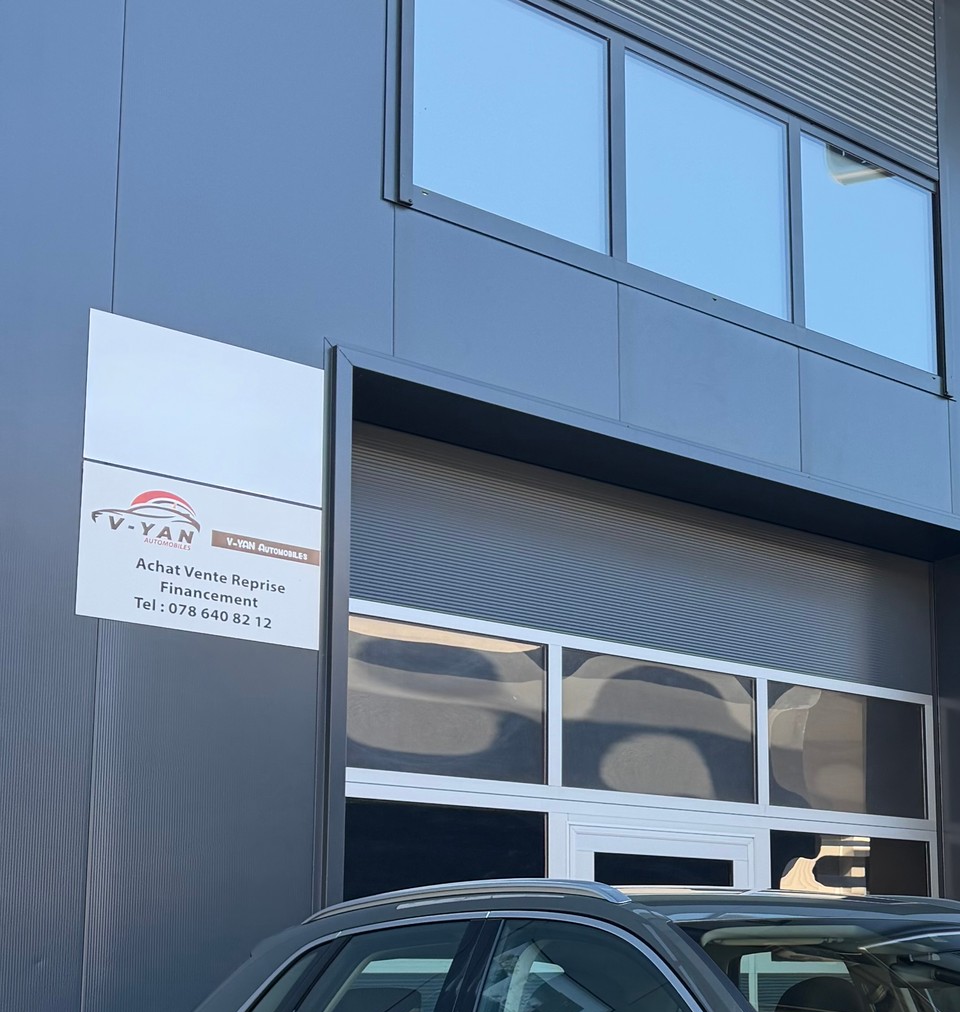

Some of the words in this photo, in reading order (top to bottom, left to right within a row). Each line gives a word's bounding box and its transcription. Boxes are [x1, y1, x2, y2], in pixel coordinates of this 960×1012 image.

[108, 515, 194, 544] V-YAN
[226, 537, 256, 551] V-YAN
[136, 557, 181, 576] Achat
[184, 565, 228, 584] Vente
[231, 574, 286, 594] Reprise
[160, 581, 259, 608] Financement
[168, 602, 197, 617] 078
[201, 608, 229, 622] 640
[232, 612, 251, 626] 82
[255, 616, 272, 629] 12
